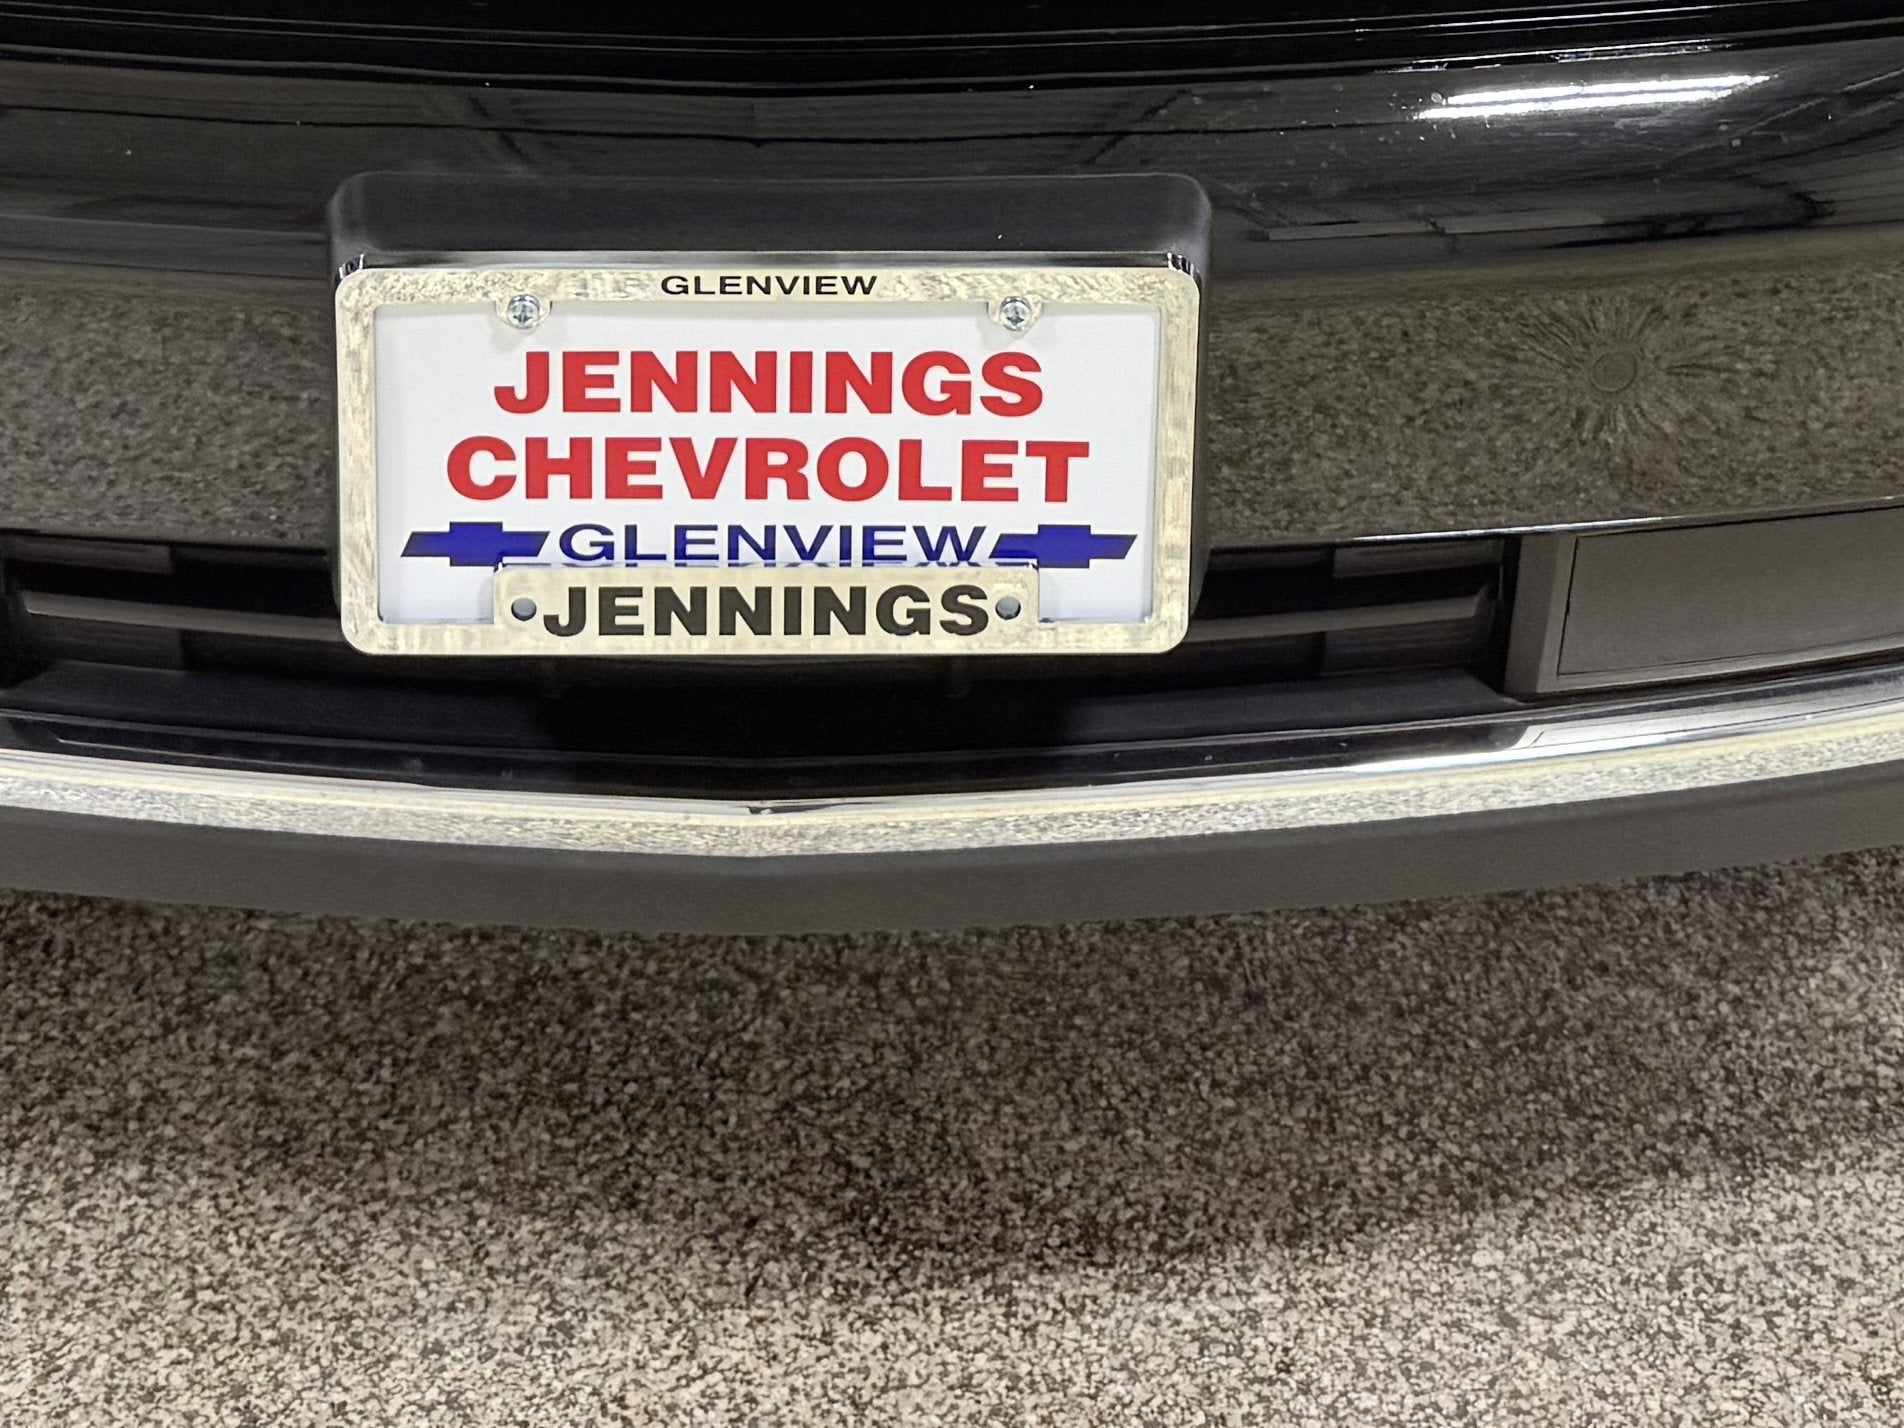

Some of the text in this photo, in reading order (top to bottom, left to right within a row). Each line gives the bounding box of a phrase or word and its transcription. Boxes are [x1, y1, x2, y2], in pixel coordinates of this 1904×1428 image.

[661, 275, 878, 296] GLENVIEW
[494, 350, 1044, 417] JENNINGS
[446, 435, 1090, 503] CHEVROLET
[559, 523, 987, 563] GLENVIEW
[542, 584, 990, 638] JENNINGS
